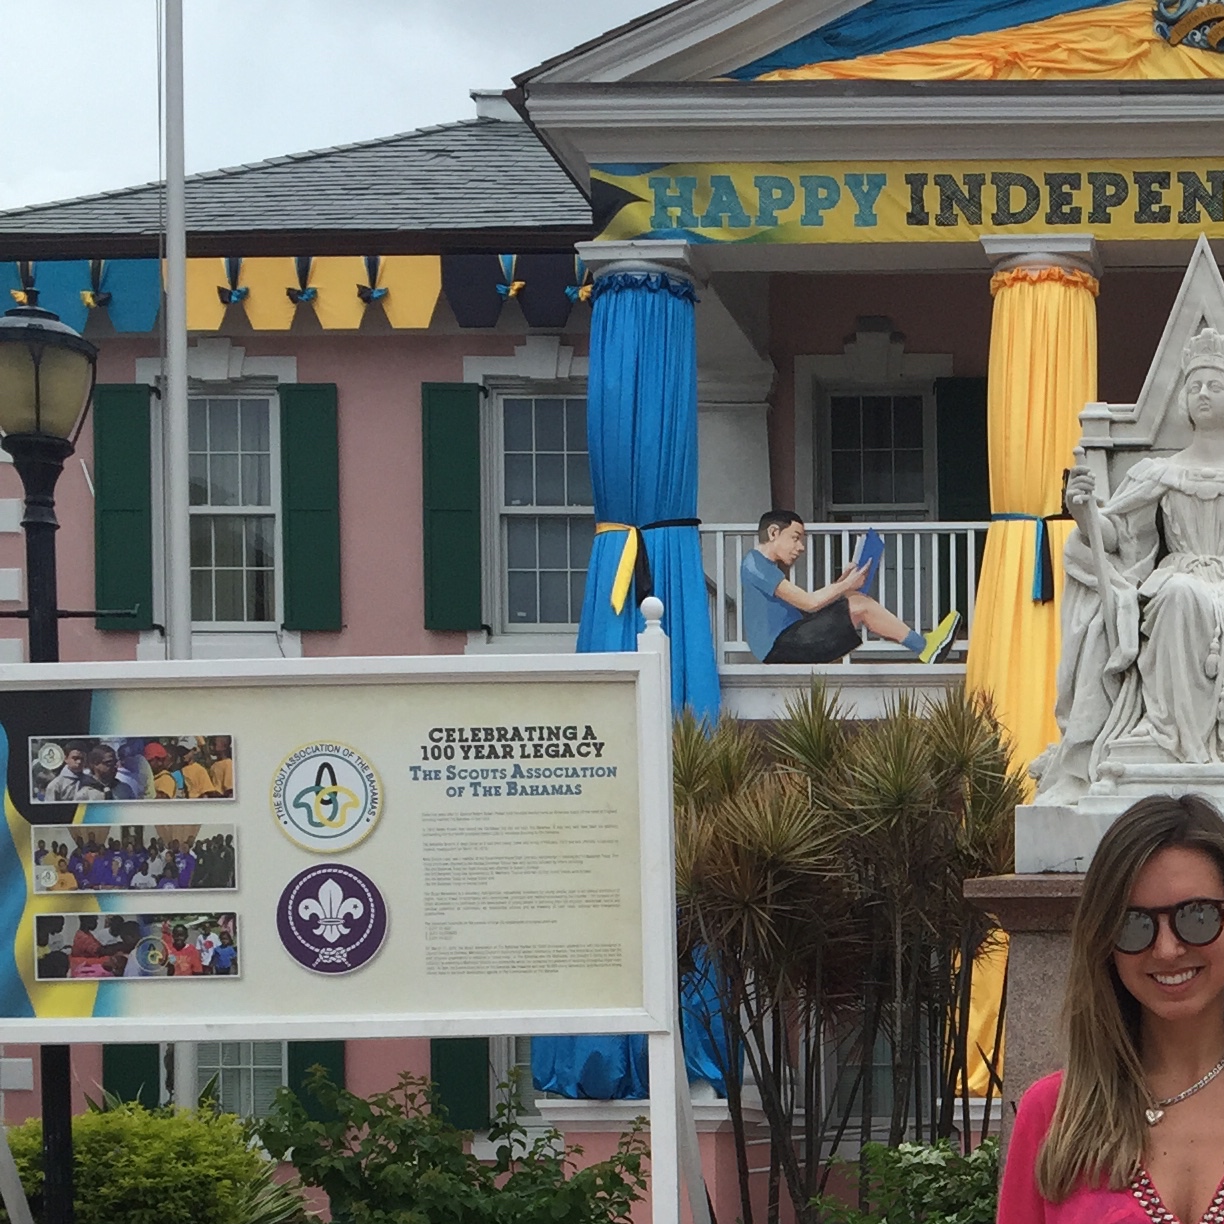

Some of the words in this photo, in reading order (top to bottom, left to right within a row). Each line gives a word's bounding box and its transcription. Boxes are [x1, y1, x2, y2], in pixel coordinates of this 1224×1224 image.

[648, 173, 888, 229] HAPPY
[428, 726, 578, 743] CELEBRATING
[582, 725, 598, 741] A
[284, 743, 341, 770] ASSOCIATION
[342, 748, 355, 758] OF
[420, 745, 455, 761] 100
[458, 744, 514, 760] YEAR
[519, 742, 605, 759] LEGACY
[354, 755, 371, 774] THE
[272, 767, 289, 798] SCOUT
[365, 772, 379, 817] BAHAMAS
[273, 800, 286, 820] THE
